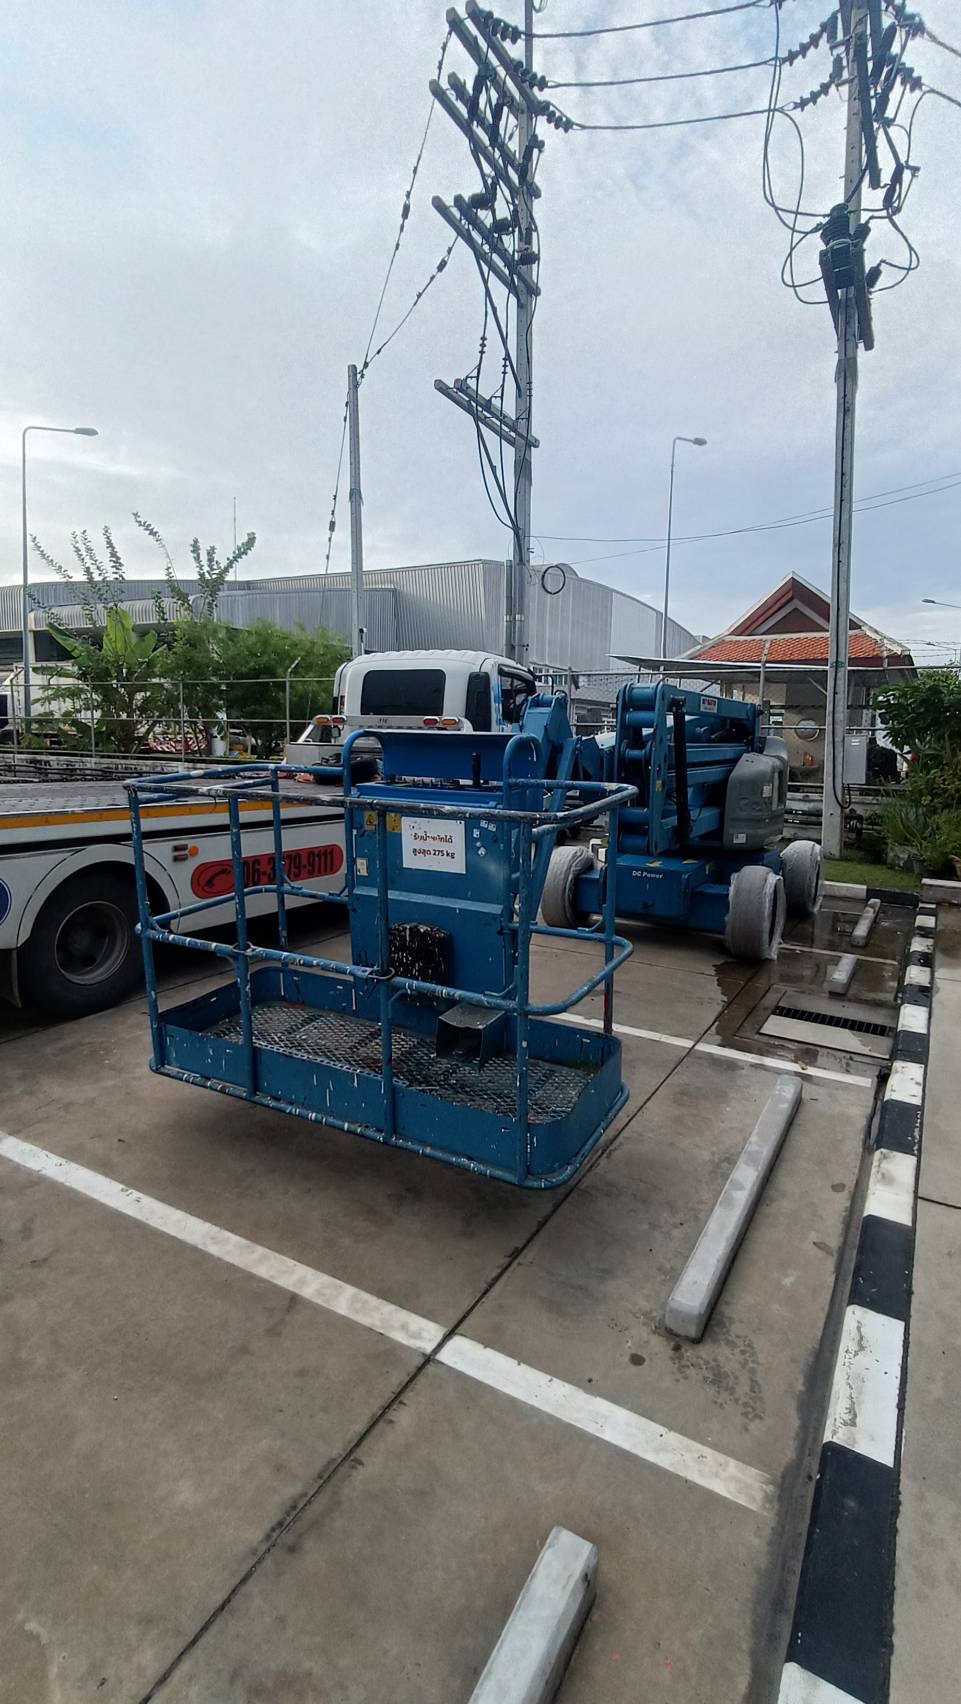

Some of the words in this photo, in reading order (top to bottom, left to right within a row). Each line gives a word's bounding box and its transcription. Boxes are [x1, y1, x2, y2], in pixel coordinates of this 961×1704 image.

[432, 849, 445, 857] 275
[445, 850, 456, 859] kg
[243, 849, 335, 887] 06-379-9111
[642, 871, 664, 879] Power
